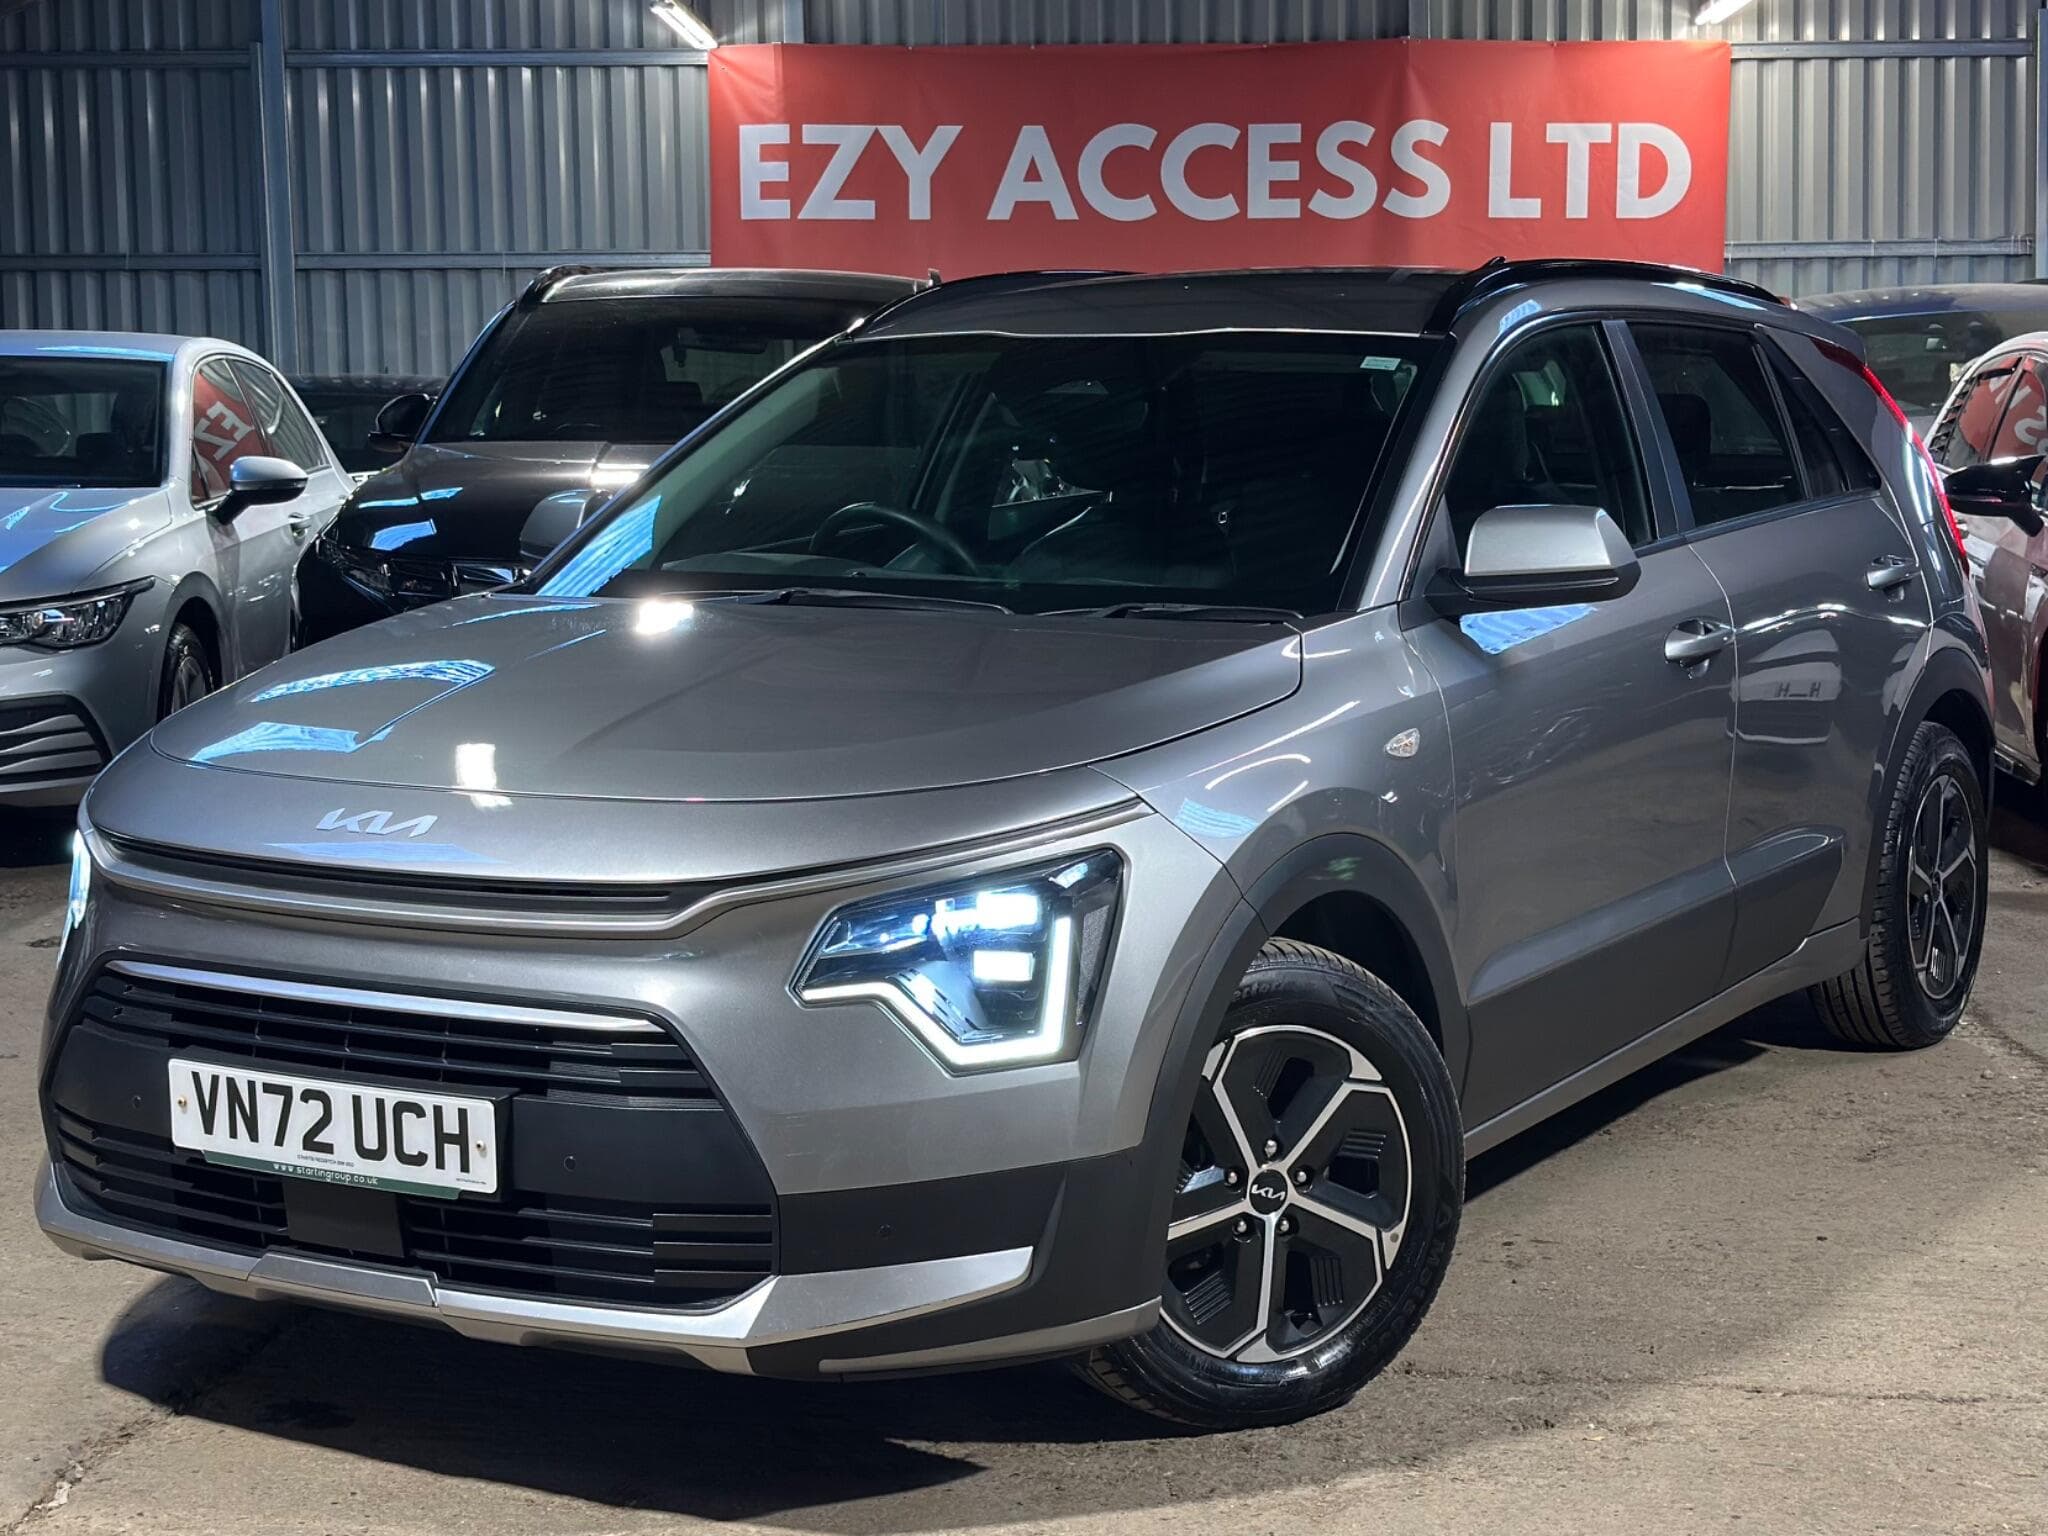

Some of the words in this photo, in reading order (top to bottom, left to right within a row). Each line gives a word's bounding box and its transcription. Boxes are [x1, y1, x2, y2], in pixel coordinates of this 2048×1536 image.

[738, 122, 963, 220] EZY
[987, 119, 1451, 222] ACCESS
[1487, 121, 1693, 220] LTD
[316, 807, 438, 838] KIA
[191, 1070, 335, 1155] VN72
[352, 1094, 470, 1174] UCH
[1251, 1183, 1286, 1201] KIA
